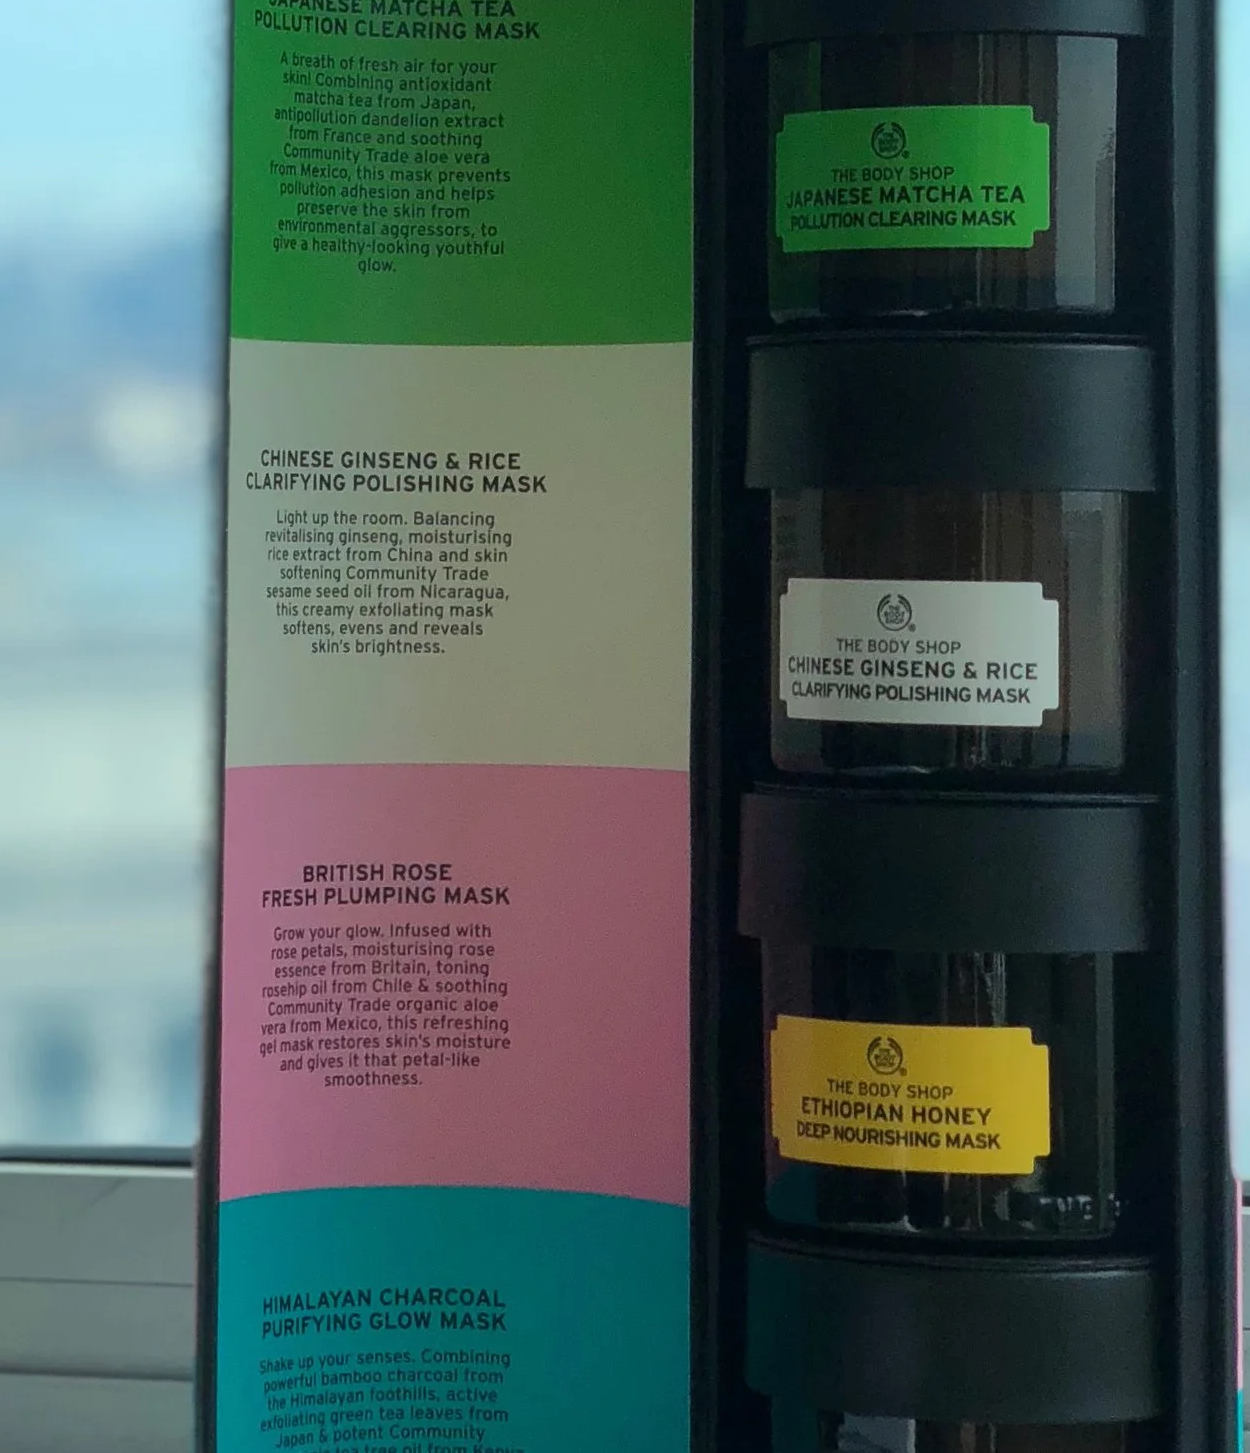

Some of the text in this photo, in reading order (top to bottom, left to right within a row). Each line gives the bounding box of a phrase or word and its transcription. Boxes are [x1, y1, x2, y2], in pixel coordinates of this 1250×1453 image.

[471, 0, 515, 16] TEA
[255, 10, 539, 39] POLLUTION CLEARING MASK
[283, 70, 491, 93] skin! Combining antioxidant
[295, 91, 475, 111] matcha tea from Japan,
[275, 107, 504, 128] antipollution dandelion extract
[290, 125, 482, 149] from France and soothing
[284, 143, 489, 164] Community Trade aloe vera
[270, 160, 510, 184] from Mexico, this mask prevents
[832, 166, 954, 182] THE BODY SHOP
[280, 181, 494, 203] pollution adhesion and helps
[787, 185, 1025, 208] JAPANESE MATCHA TEA
[278, 219, 497, 239] environmental aggressors, to
[791, 211, 1016, 231] POLLUTION CLEARING MASK
[261, 450, 520, 469] CHINESE GINSENG & RICE
[246, 472, 546, 492] CLARIFYING POLISHING MASK
[277, 510, 494, 529] Light up the room. Balancing
[266, 529, 511, 547] revitalising ginseng, moisturising
[280, 566, 488, 583] softening Community Trade
[267, 584, 508, 601] sesame seed oil from Nicaragua,
[276, 603, 493, 619] this creamy exfoliating mask
[283, 621, 483, 635] softens, evens and reveals
[312, 640, 445, 656] skin's brightness.
[837, 638, 961, 654] THE BODY SHOP
[789, 656, 1037, 680] CHINESE GINSENG & RICE
[792, 681, 1030, 703] CLARIFYING POLISHING MASK
[303, 864, 451, 882] BRITISH ROSE
[263, 887, 509, 907] FRESH PLUMPING MASK
[274, 923, 491, 942] Grow your glow. Infused with
[271, 942, 494, 960] rose petals, moisturising rose
[275, 960, 489, 978] essence from Britain, toning
[268, 998, 498, 1016] Community Trade organic aloe
[325, 1072, 422, 1087] smoothness.
[827, 1079, 953, 1099] THE BODY SHOP
[802, 1096, 991, 1125] ETHIOPIAN HONEY
[797, 1120, 1000, 1149] DEEP NOURISHING MASK
[263, 1288, 505, 1315] HIMALAYAN CHARCOAL
[263, 1312, 506, 1339] PURIFYING GLOW MASK
[260, 1348, 510, 1374] Shake up your senses. Combining
[264, 1369, 503, 1396] powerful bamboo charcoal from
[268, 1387, 497, 1411] the Himalayan foothills, active
